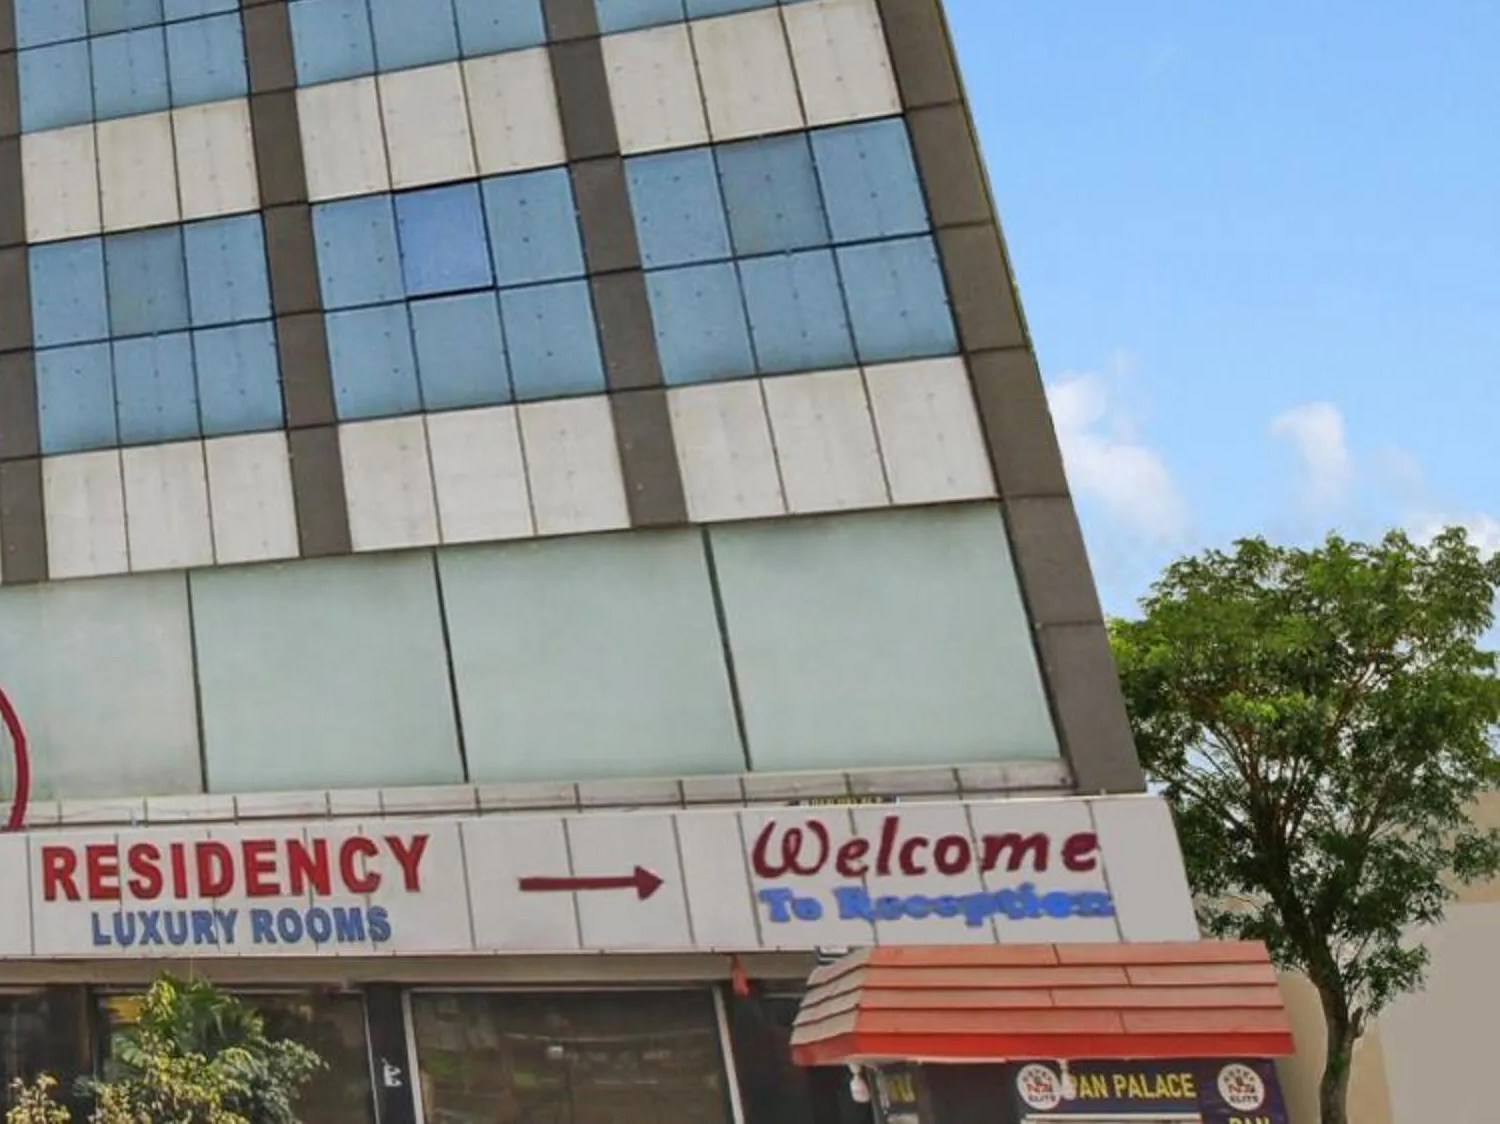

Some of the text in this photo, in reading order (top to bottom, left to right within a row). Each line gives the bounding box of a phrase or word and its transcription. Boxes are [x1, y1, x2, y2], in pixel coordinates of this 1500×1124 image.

[42, 834, 429, 902] RESIDENCY
[752, 815, 1098, 879] Welcome
[91, 905, 392, 947] LUXURY ROOMS
[759, 881, 1116, 927] To Reception
[1113, 1072, 1197, 1099] PALACE
